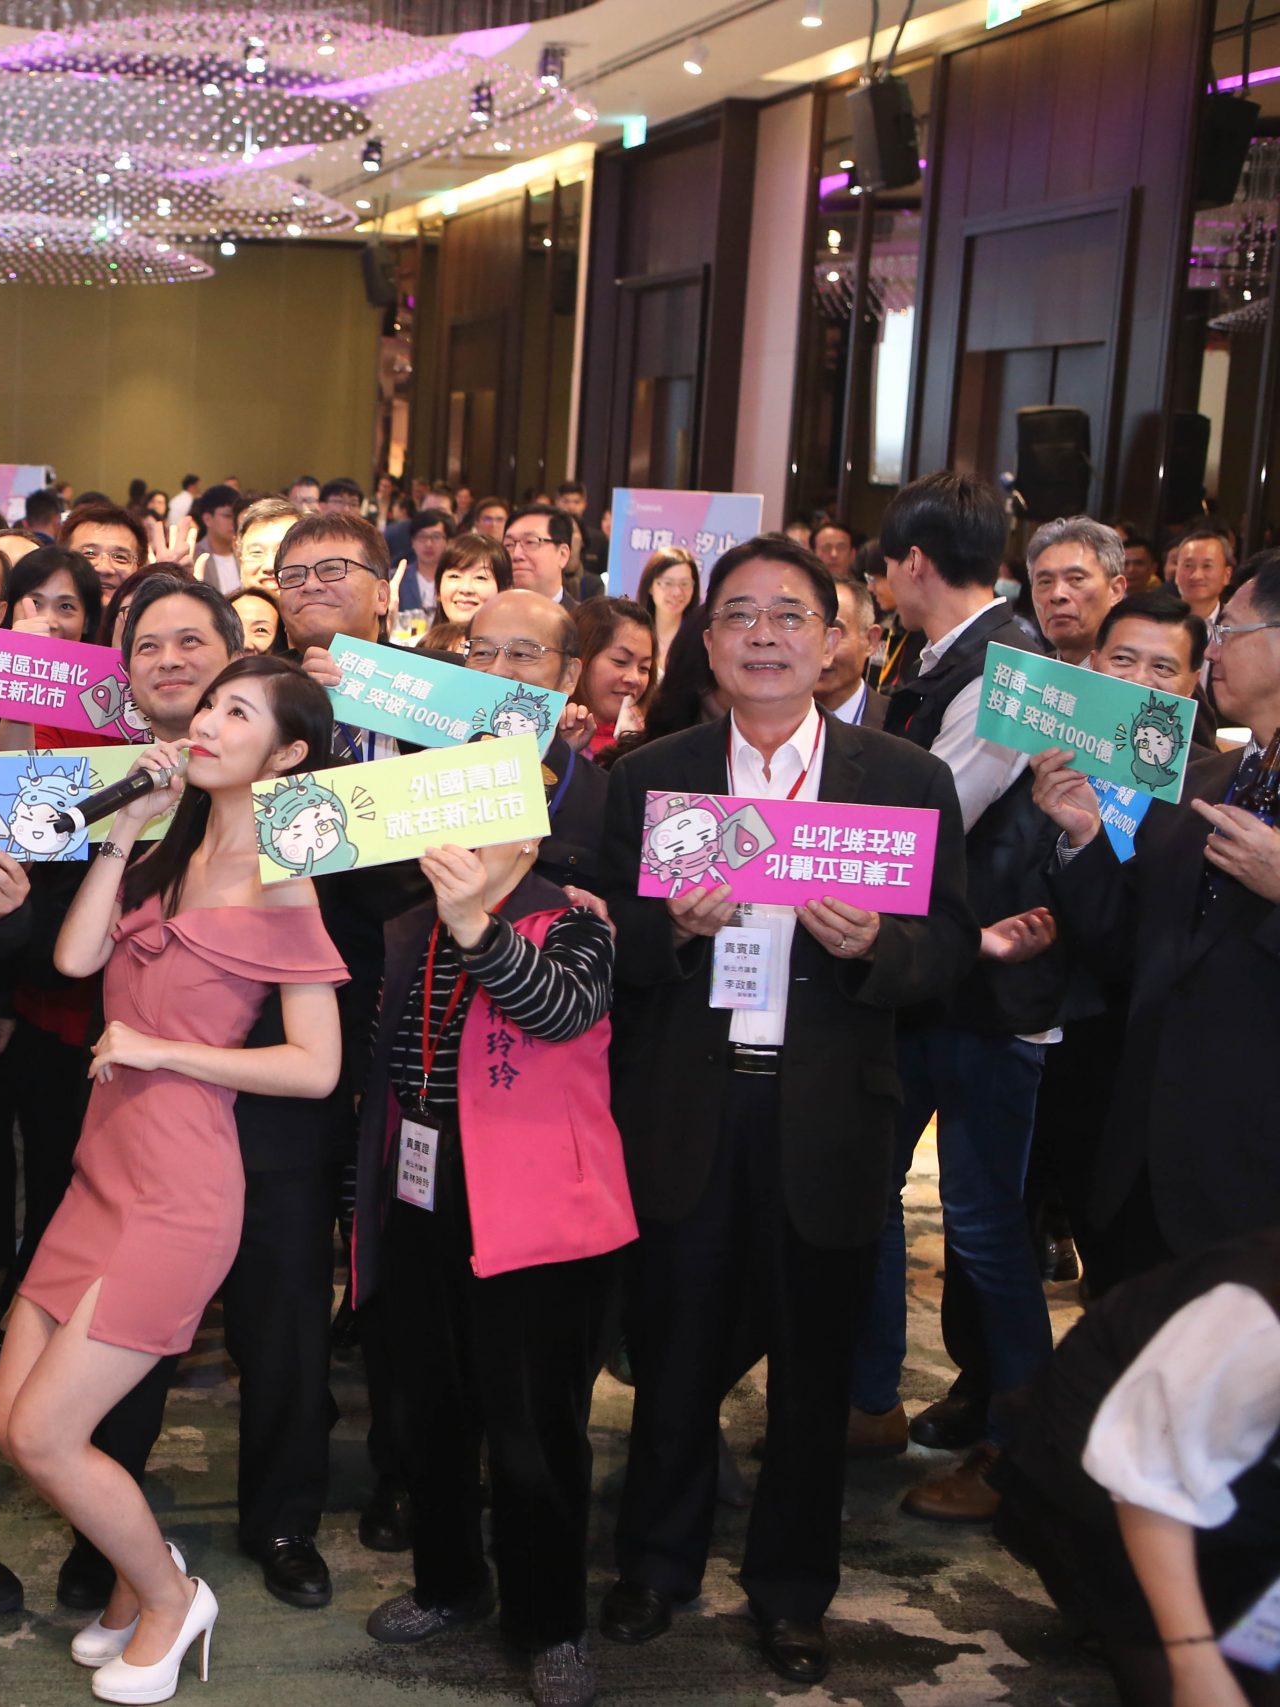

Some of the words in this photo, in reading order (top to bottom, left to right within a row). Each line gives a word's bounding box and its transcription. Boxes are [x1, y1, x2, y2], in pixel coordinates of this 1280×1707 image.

[337, 650, 434, 700] 招商一條龍
[992, 662, 1077, 717] 招商一條龍
[363, 687, 471, 741] 突破1000億
[987, 688, 1022, 721] 投資
[1022, 705, 1114, 764] 突破1000億
[409, 757, 520, 802] 外國青創
[385, 793, 526, 839] 就在新北市
[792, 824, 917, 857] 就在新北市
[765, 854, 914, 886] 工業區立體化
[724, 942, 760, 955] 貴賓證
